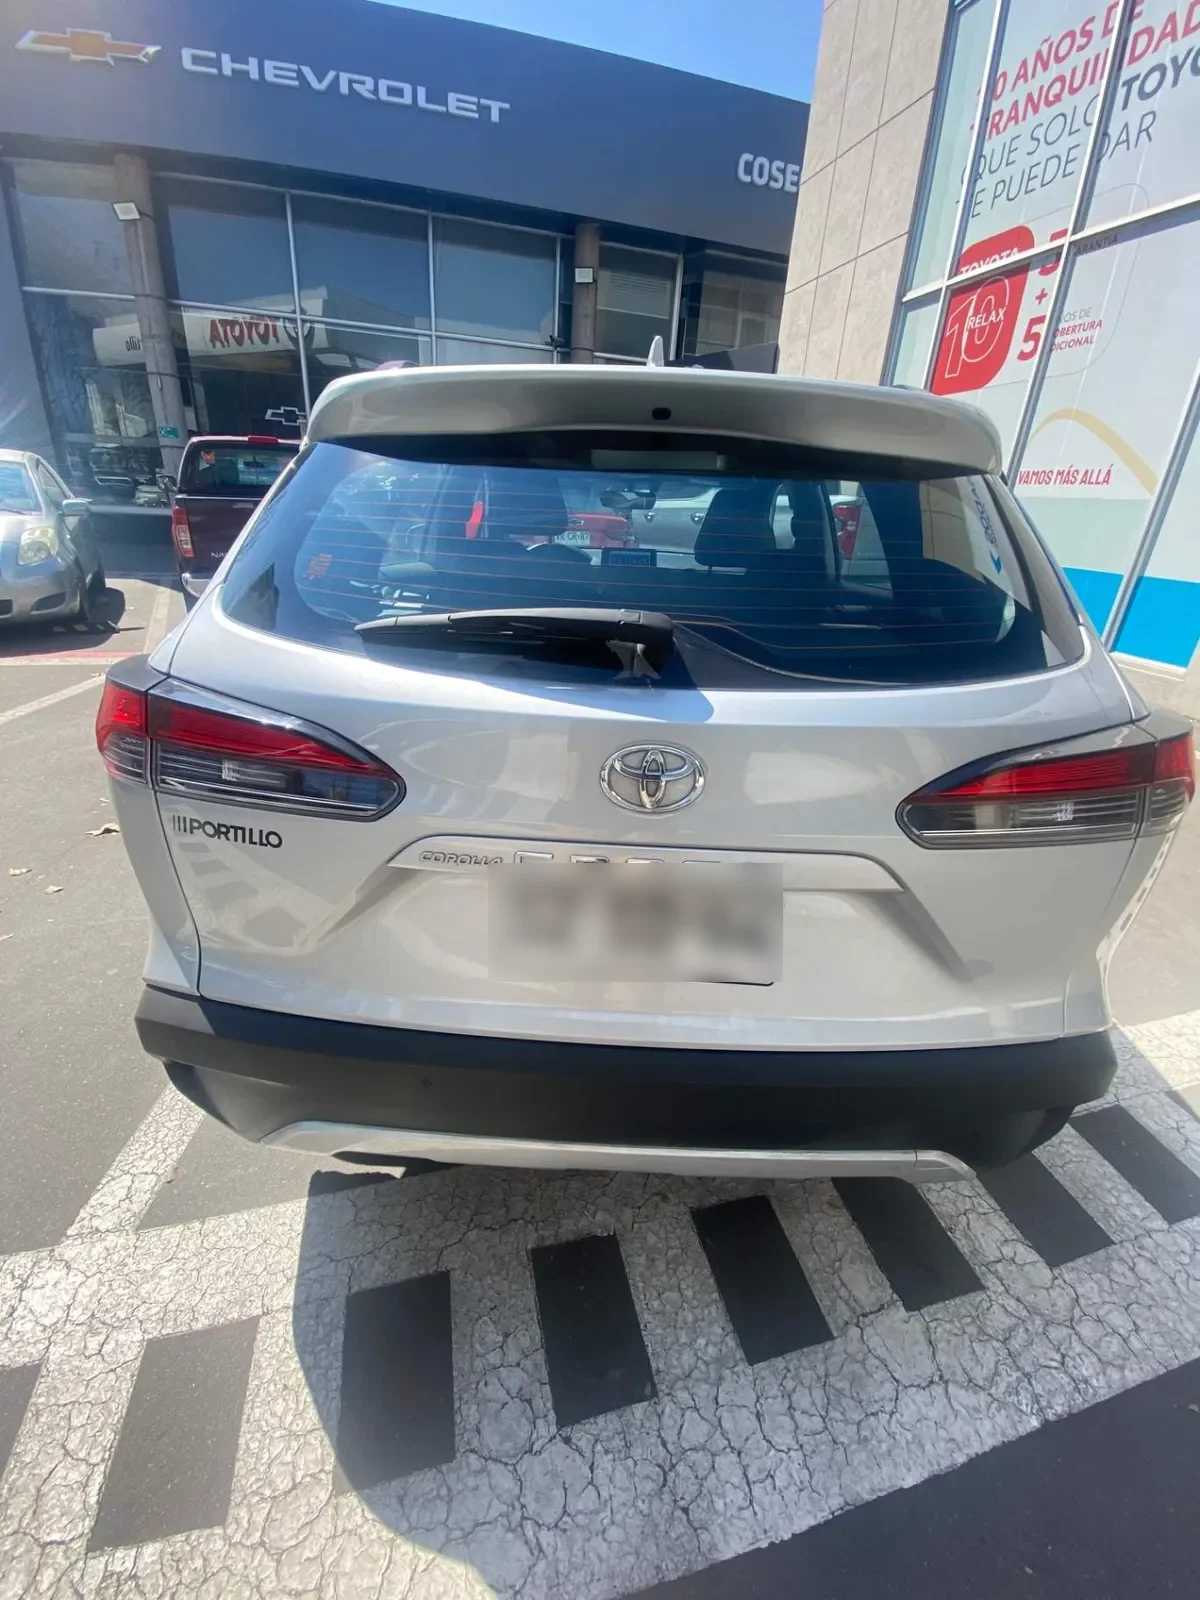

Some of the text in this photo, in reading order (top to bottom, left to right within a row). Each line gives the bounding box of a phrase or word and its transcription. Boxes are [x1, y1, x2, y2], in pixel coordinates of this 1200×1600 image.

[1010, 16, 1096, 92] AÑOS
[181, 47, 510, 123] CHEVROLET
[991, 143, 1081, 210] PUEDE
[967, 308, 1005, 332] RELAX
[1079, 307, 1093, 319] DE
[1017, 315, 1047, 361] 5
[1054, 319, 1103, 338] OBERTURA
[1051, 335, 1094, 352] DICIONAL
[1018, 463, 1114, 485] VAMOS MÁS ALLÁ
[210, 551, 229, 559] NA
[189, 817, 283, 849] PORTILLO
